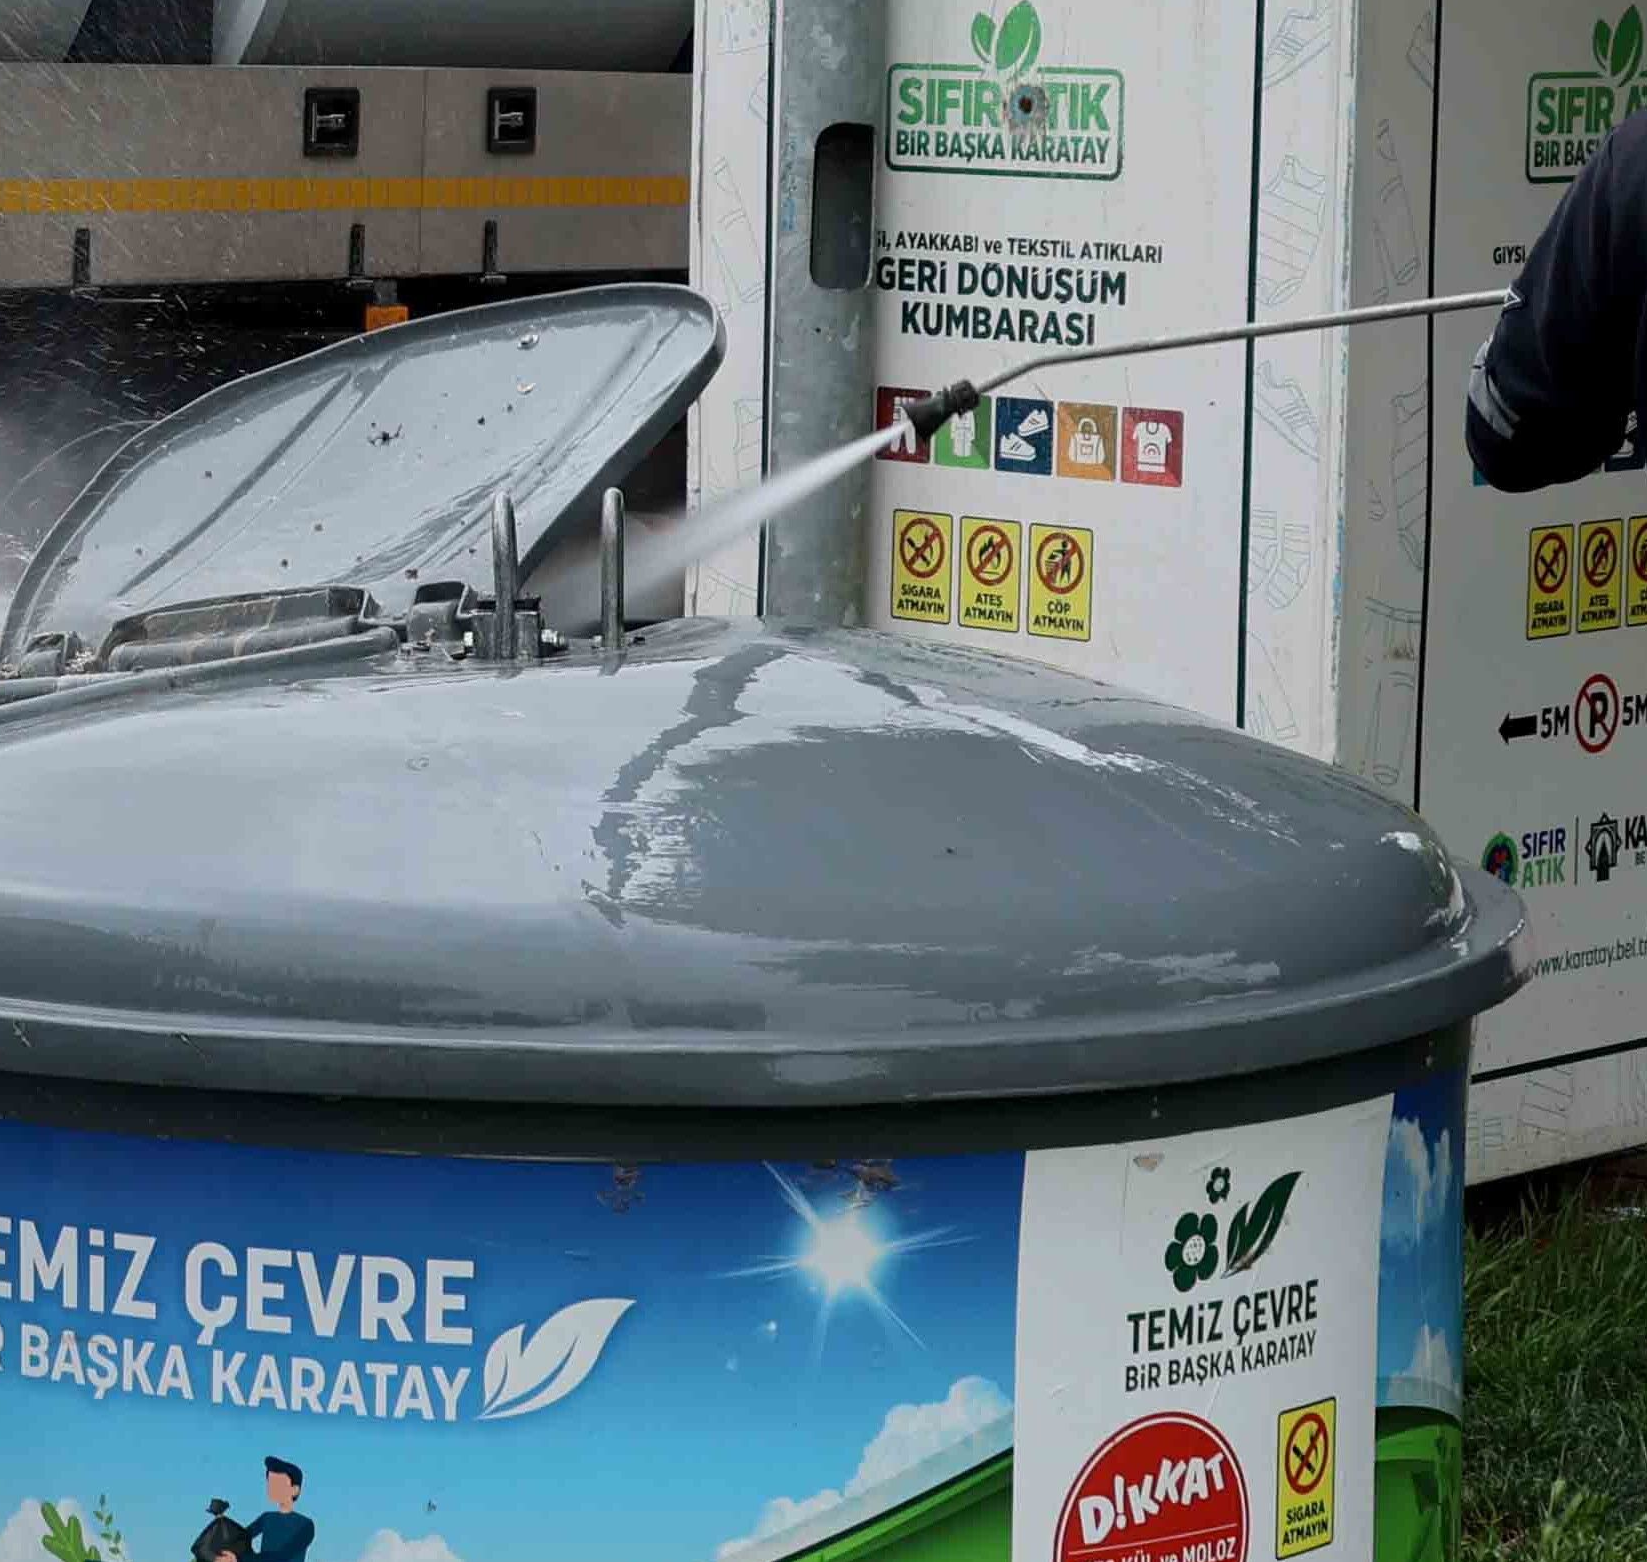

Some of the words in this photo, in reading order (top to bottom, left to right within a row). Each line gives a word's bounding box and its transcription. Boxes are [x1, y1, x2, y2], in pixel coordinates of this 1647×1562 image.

[898, 77, 1000, 128] SIFIR
[1007, 79, 1111, 132] TIK
[1535, 86, 1615, 136] SIFIR
[934, 131, 1005, 165] BAŞKA
[1010, 135, 1111, 165] KARATAY
[895, 231, 979, 253] AYAKKABI
[1080, 243, 1163, 264] ATIKLARI
[902, 301, 1095, 347] KUMBARASI
[896, 598, 945, 616] ATMAYIN
[964, 605, 1013, 623] ATMAYIN
[1033, 613, 1085, 633] ATMAYIN
[1541, 705, 1570, 739] 5M
[1521, 827, 1567, 860] SIFIR
[1522, 855, 1566, 888] ATIK
[183, 1241, 476, 1350] ÇEVRE
[1233, 1278, 1320, 1347] ÇEVRE
[21, 1321, 195, 1400] BAŞKA
[211, 1350, 472, 1423] KARATAY
[1167, 1346, 1237, 1387] BAŞKA
[1240, 1330, 1317, 1374] KARATAY
[1282, 1516, 1330, 1546] ATMAYIN
